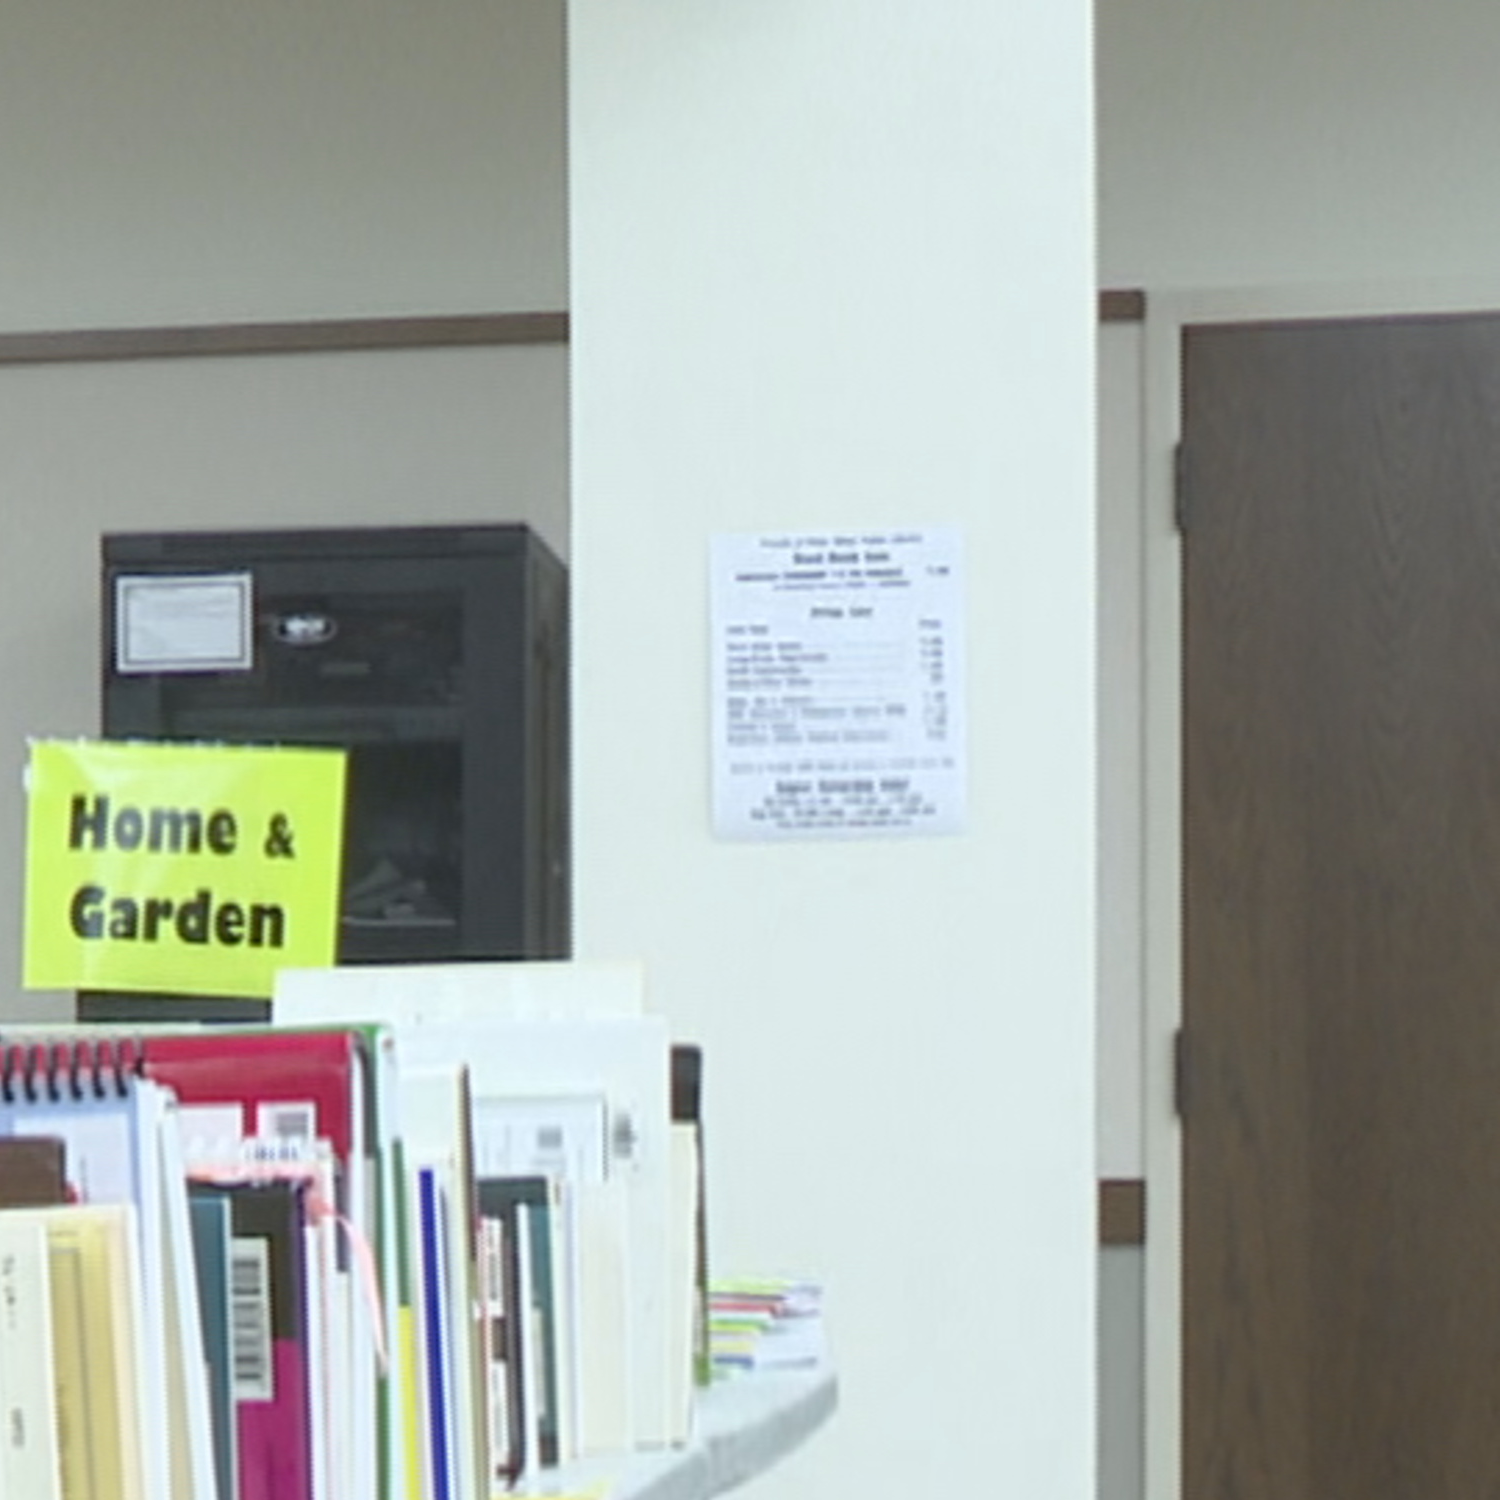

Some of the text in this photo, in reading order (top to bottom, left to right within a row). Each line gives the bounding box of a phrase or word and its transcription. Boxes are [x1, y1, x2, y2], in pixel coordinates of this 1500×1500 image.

[68, 794, 296, 859] Home &
[68, 886, 285, 949] Garden
